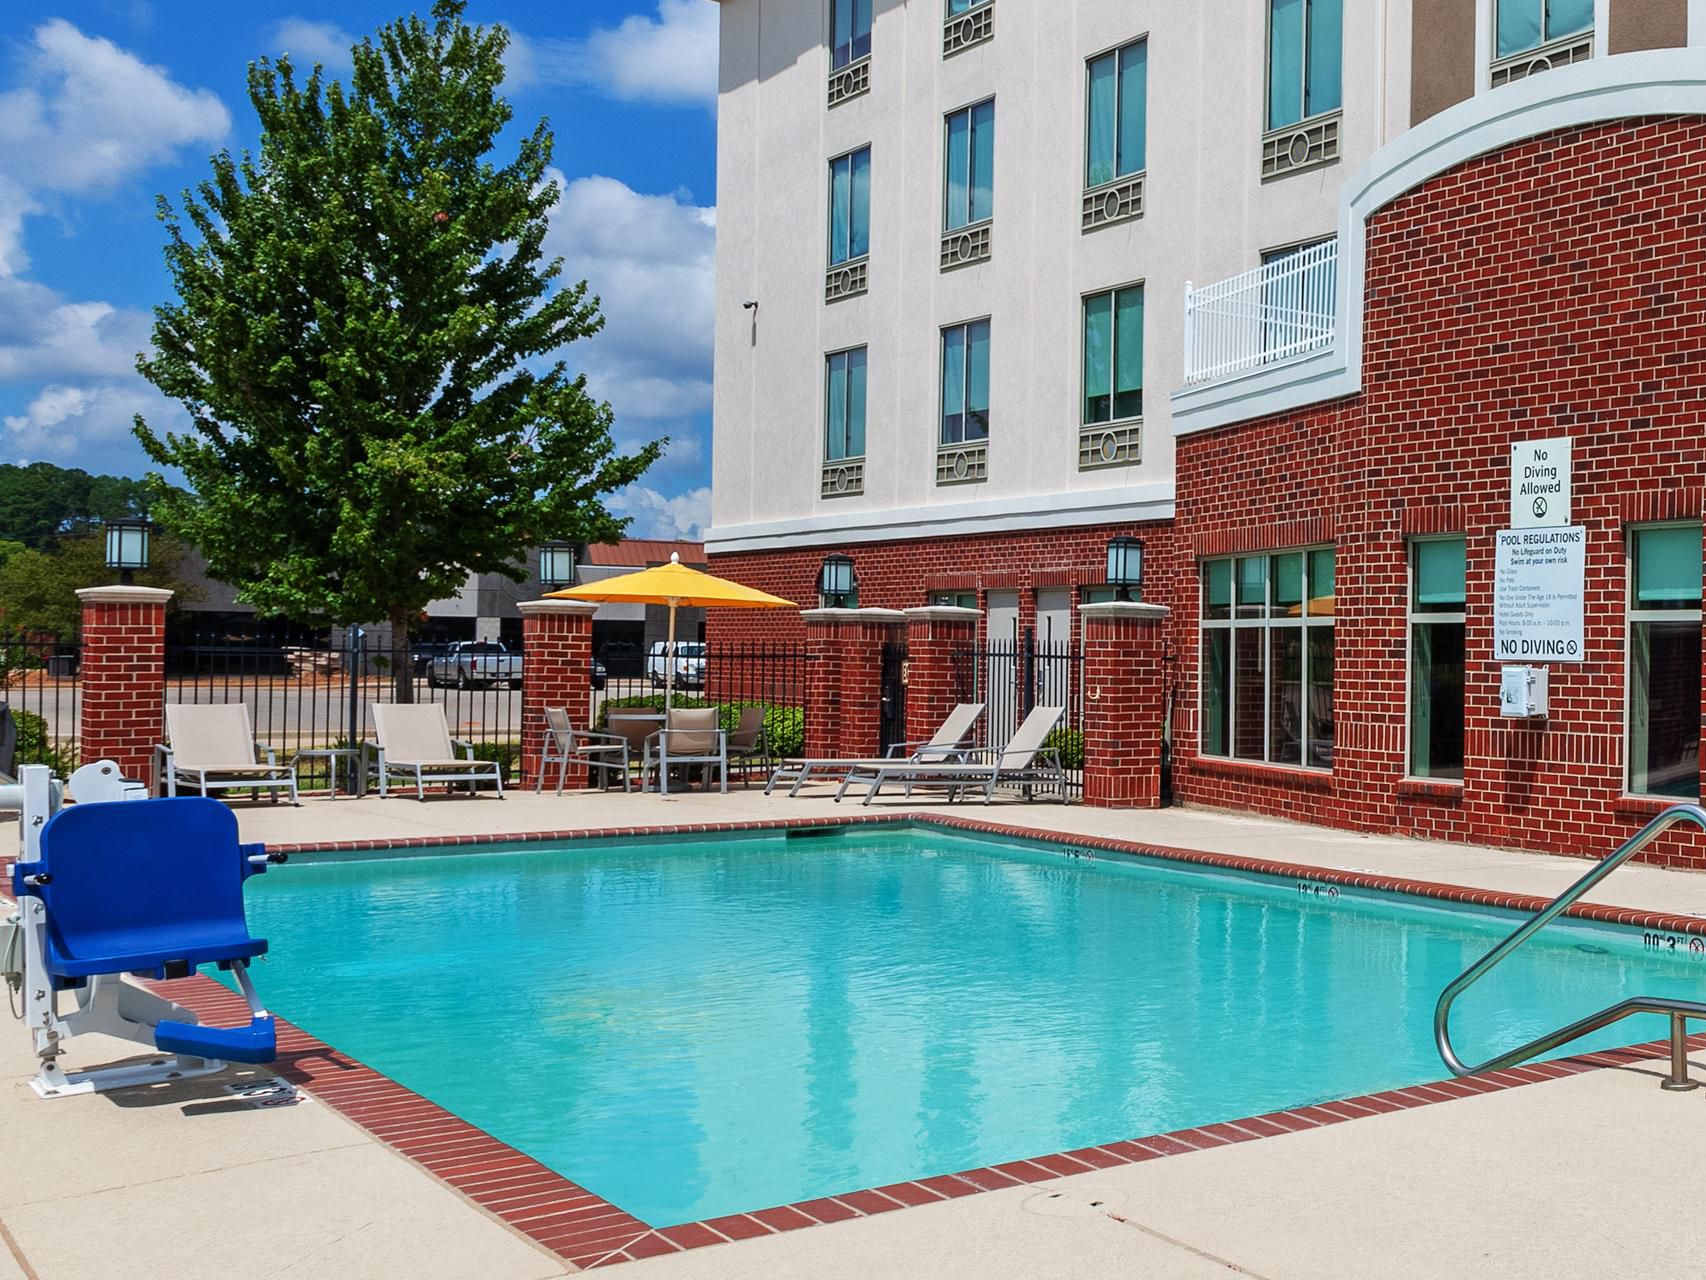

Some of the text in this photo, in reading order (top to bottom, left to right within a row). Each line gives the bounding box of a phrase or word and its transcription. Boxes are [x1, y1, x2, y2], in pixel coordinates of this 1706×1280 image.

[1534, 449, 1548, 461] No
[1524, 466, 1557, 480] Diving
[1520, 480, 1561, 495] Allowed
[1501, 532, 1580, 545] POOL REGULATIONS
[1521, 548, 1544, 556] Lifeguard
[1554, 547, 1567, 555] Duty
[1532, 558, 1544, 566] your
[1557, 556, 1568, 564] risk
[1501, 639, 1565, 655] NO DIVING
